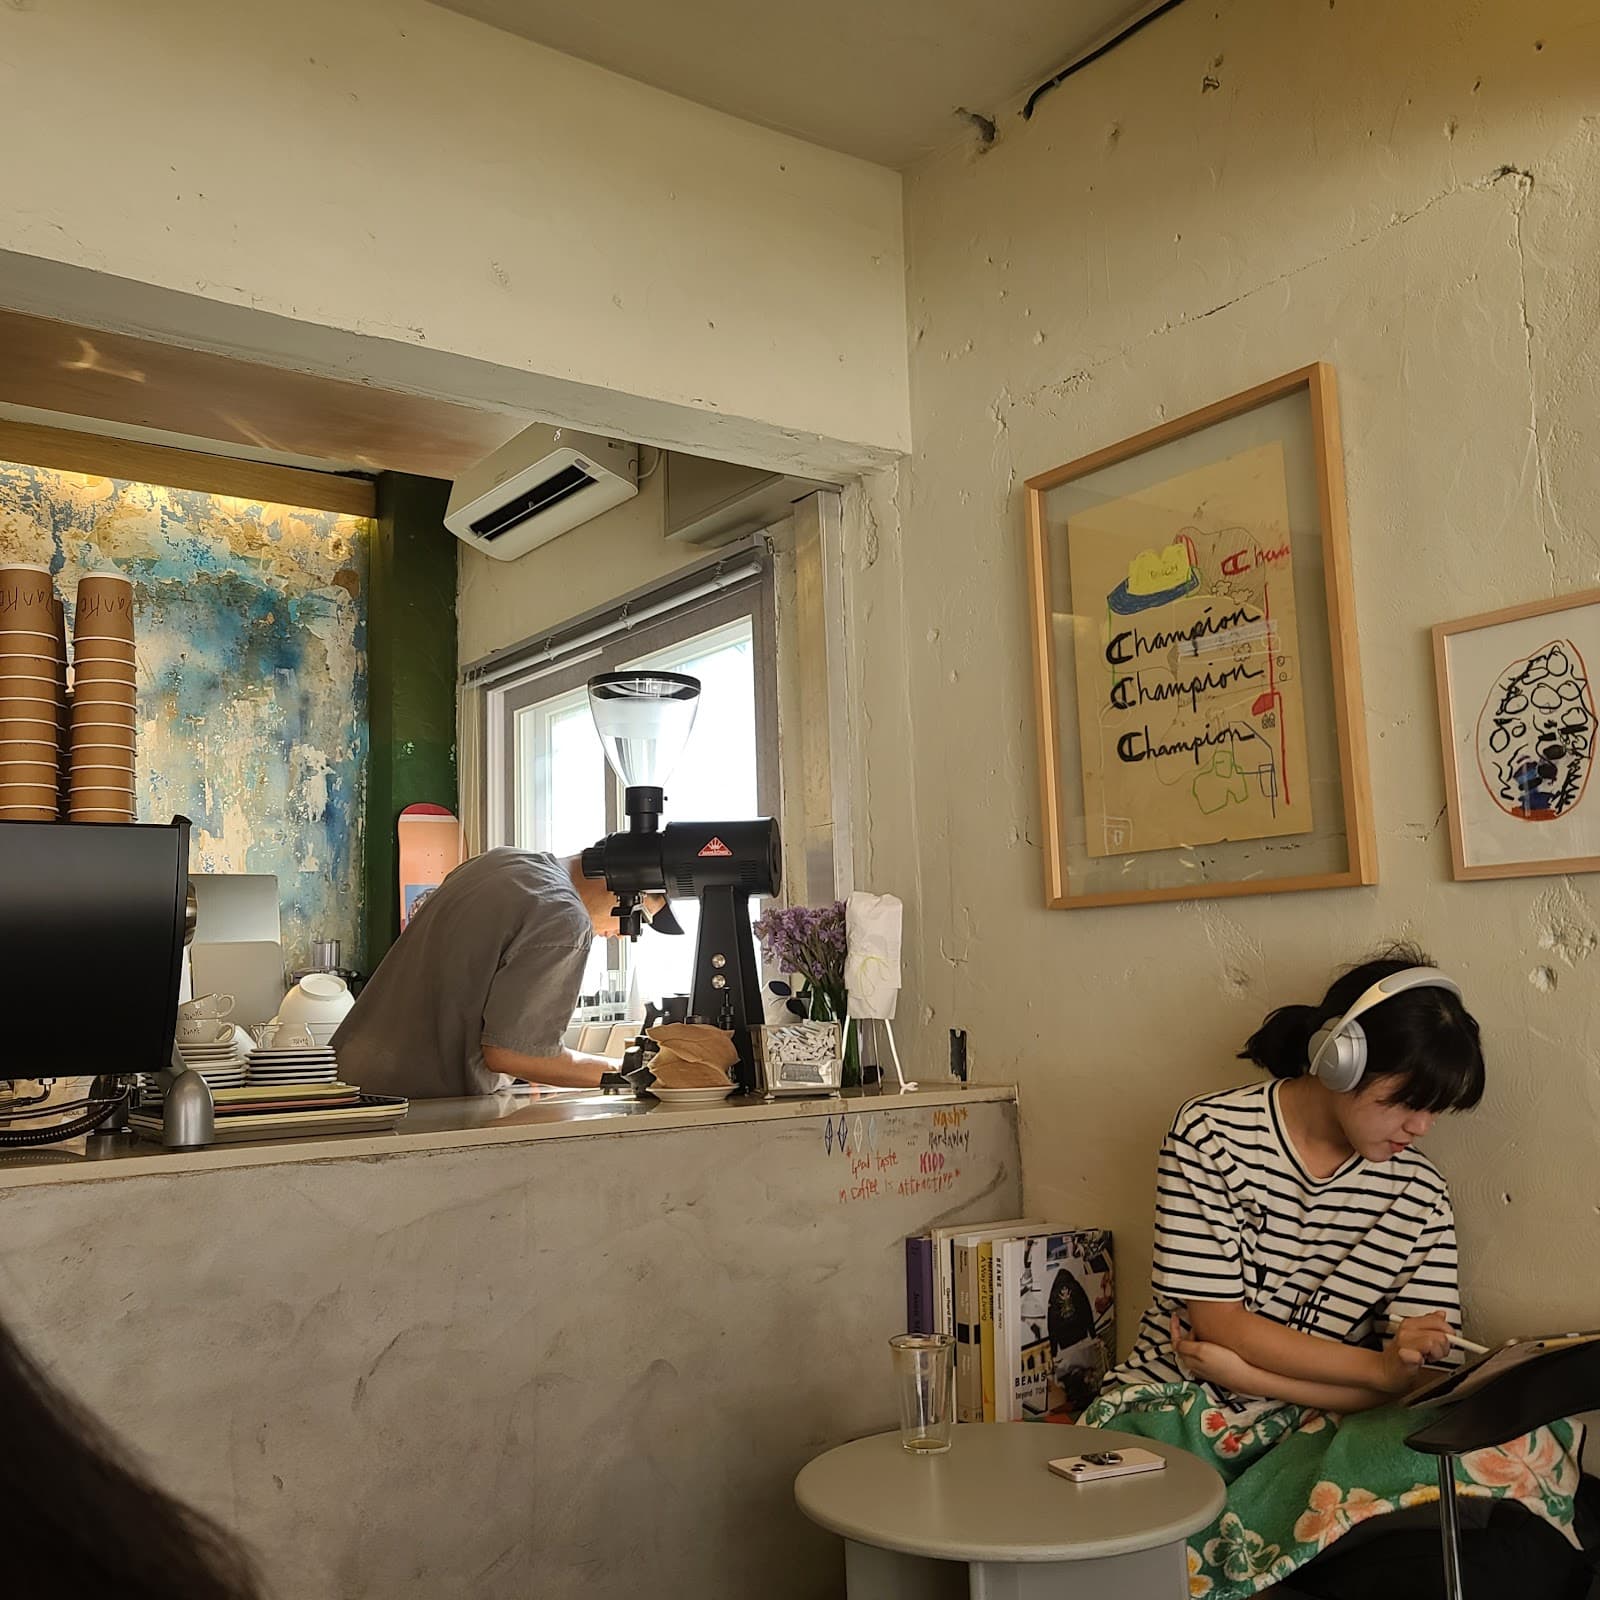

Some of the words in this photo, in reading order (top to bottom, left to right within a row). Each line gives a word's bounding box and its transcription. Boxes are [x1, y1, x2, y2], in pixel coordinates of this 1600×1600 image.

[1106, 607, 1261, 665] Champion
[1111, 663, 1265, 712] Champion
[1117, 724, 1256, 765] Champion
[1014, 1371, 1047, 1388] BEAMS
